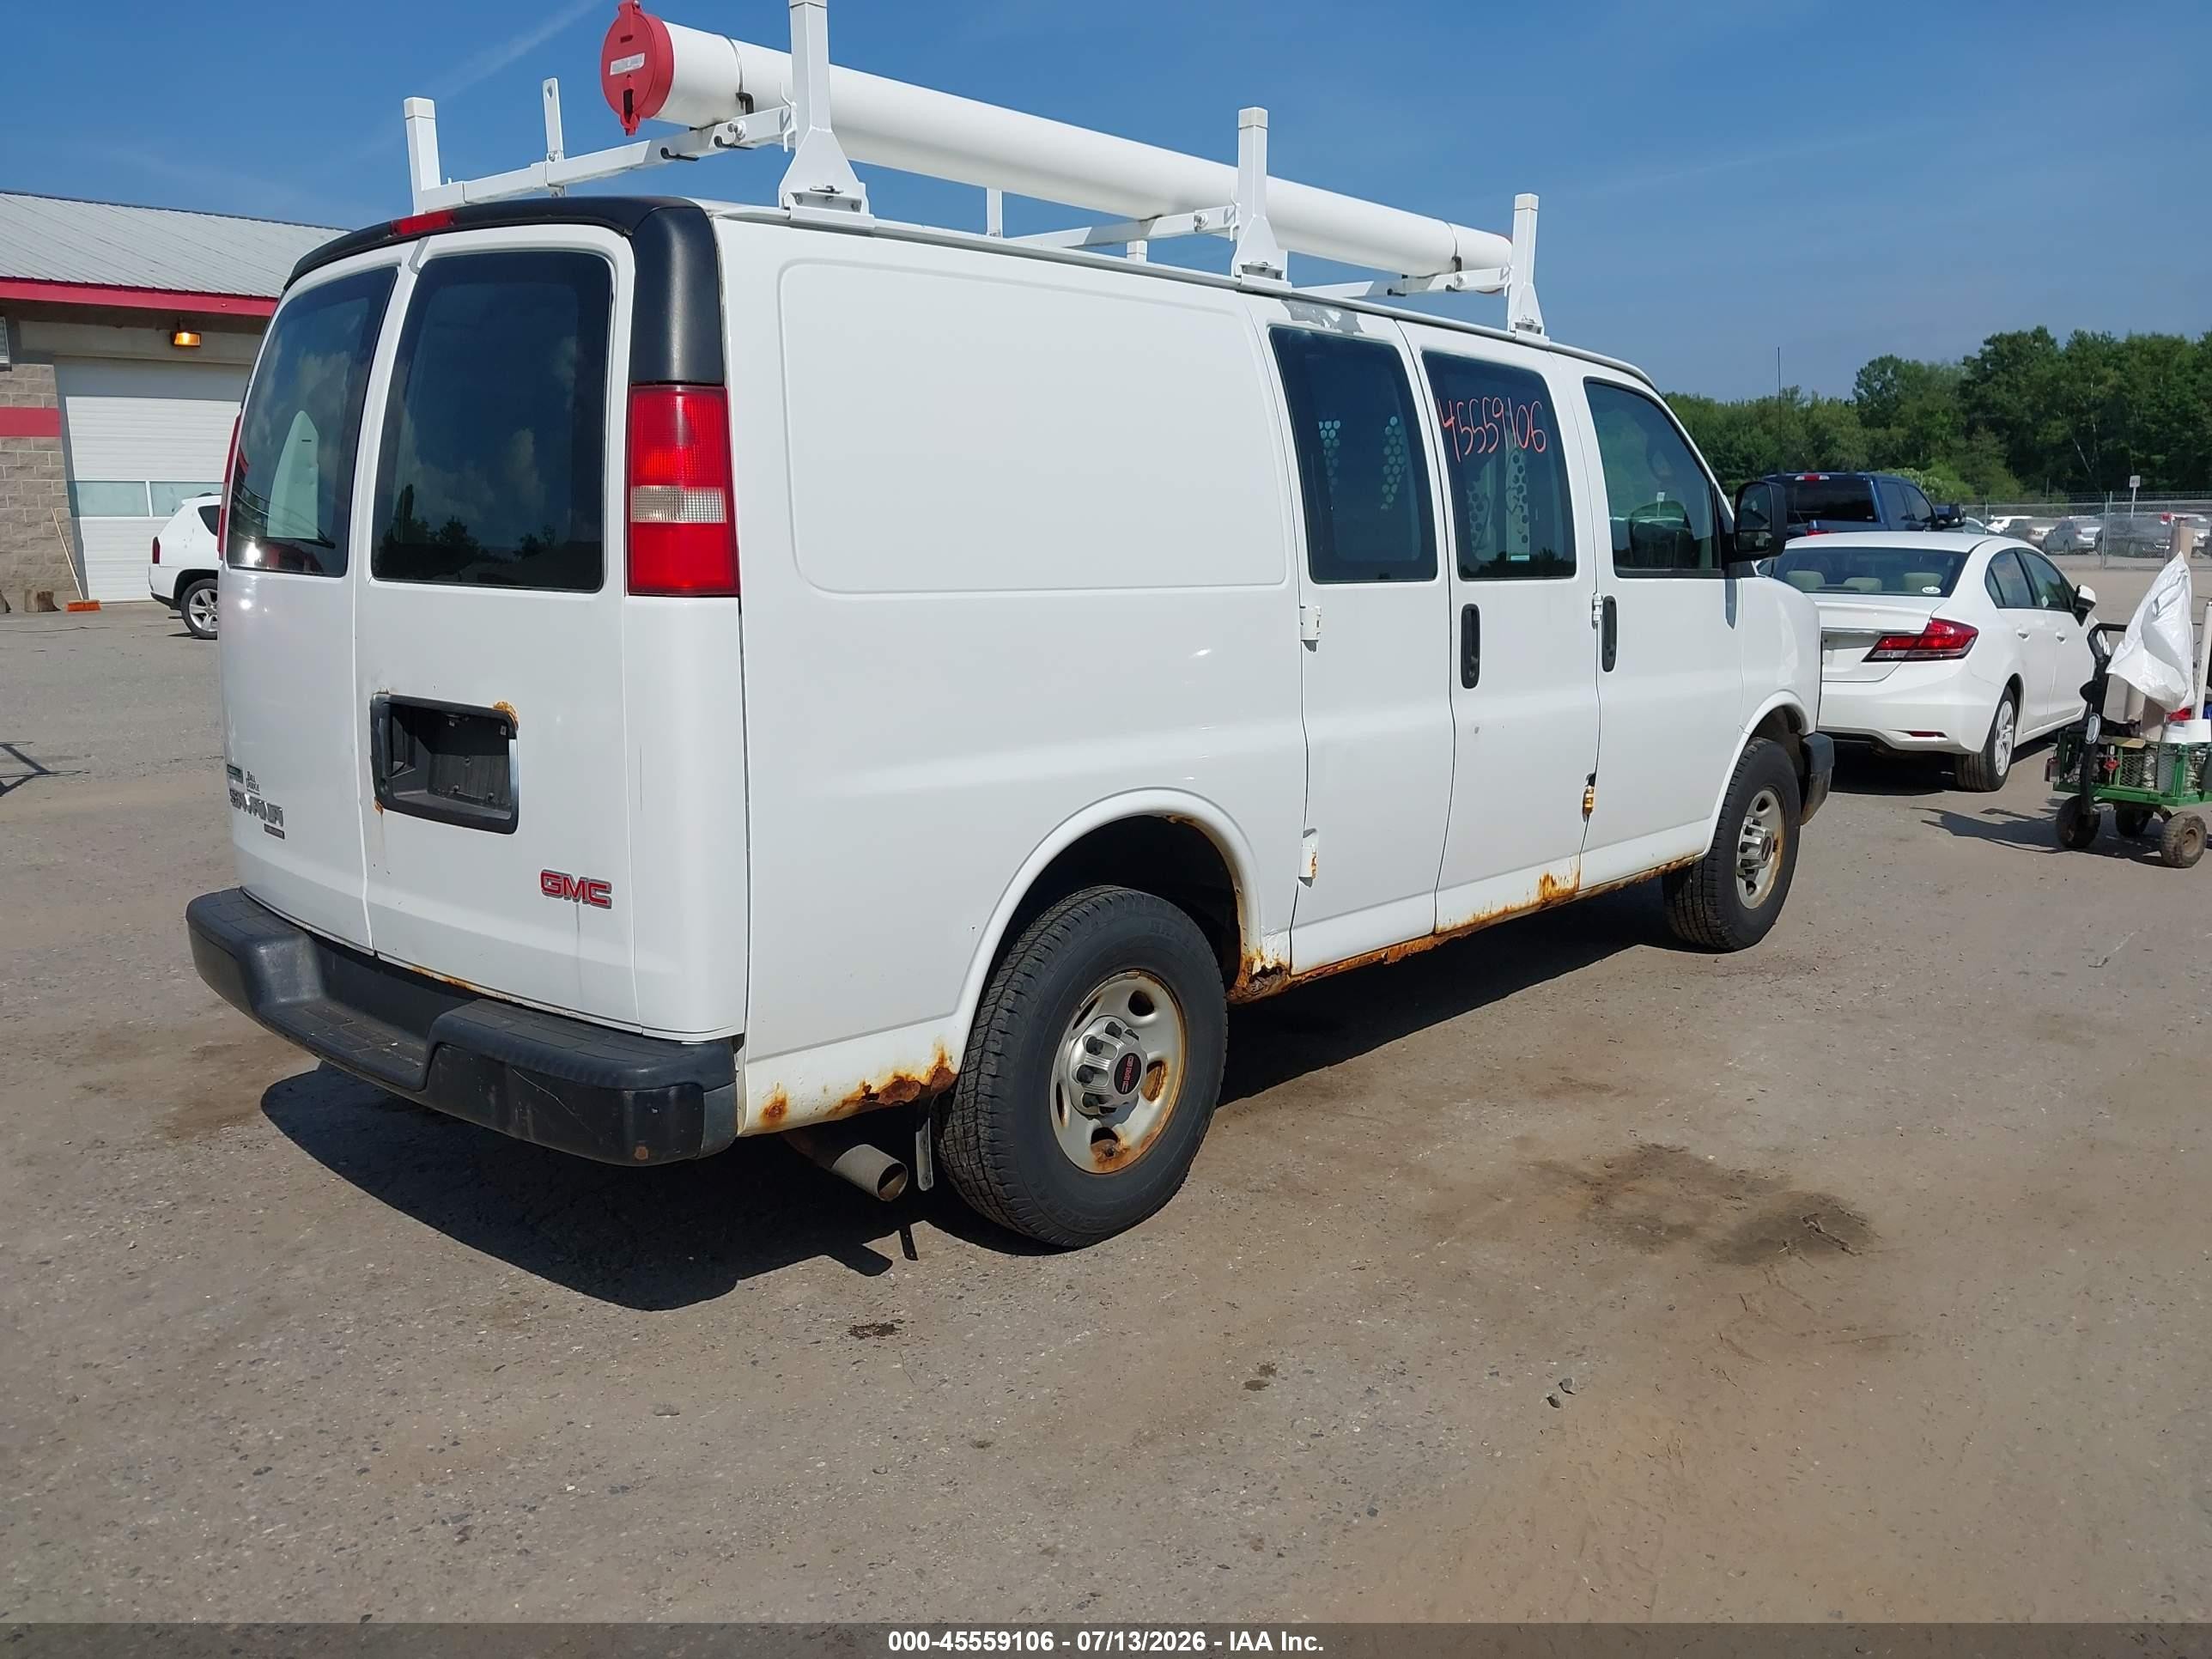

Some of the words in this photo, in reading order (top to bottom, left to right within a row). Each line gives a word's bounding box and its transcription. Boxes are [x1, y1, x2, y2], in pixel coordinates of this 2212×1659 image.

[1437, 397, 1547, 463] 45559106
[540, 868, 613, 910] GMC
[1121, 1055, 1134, 1093] GMC
